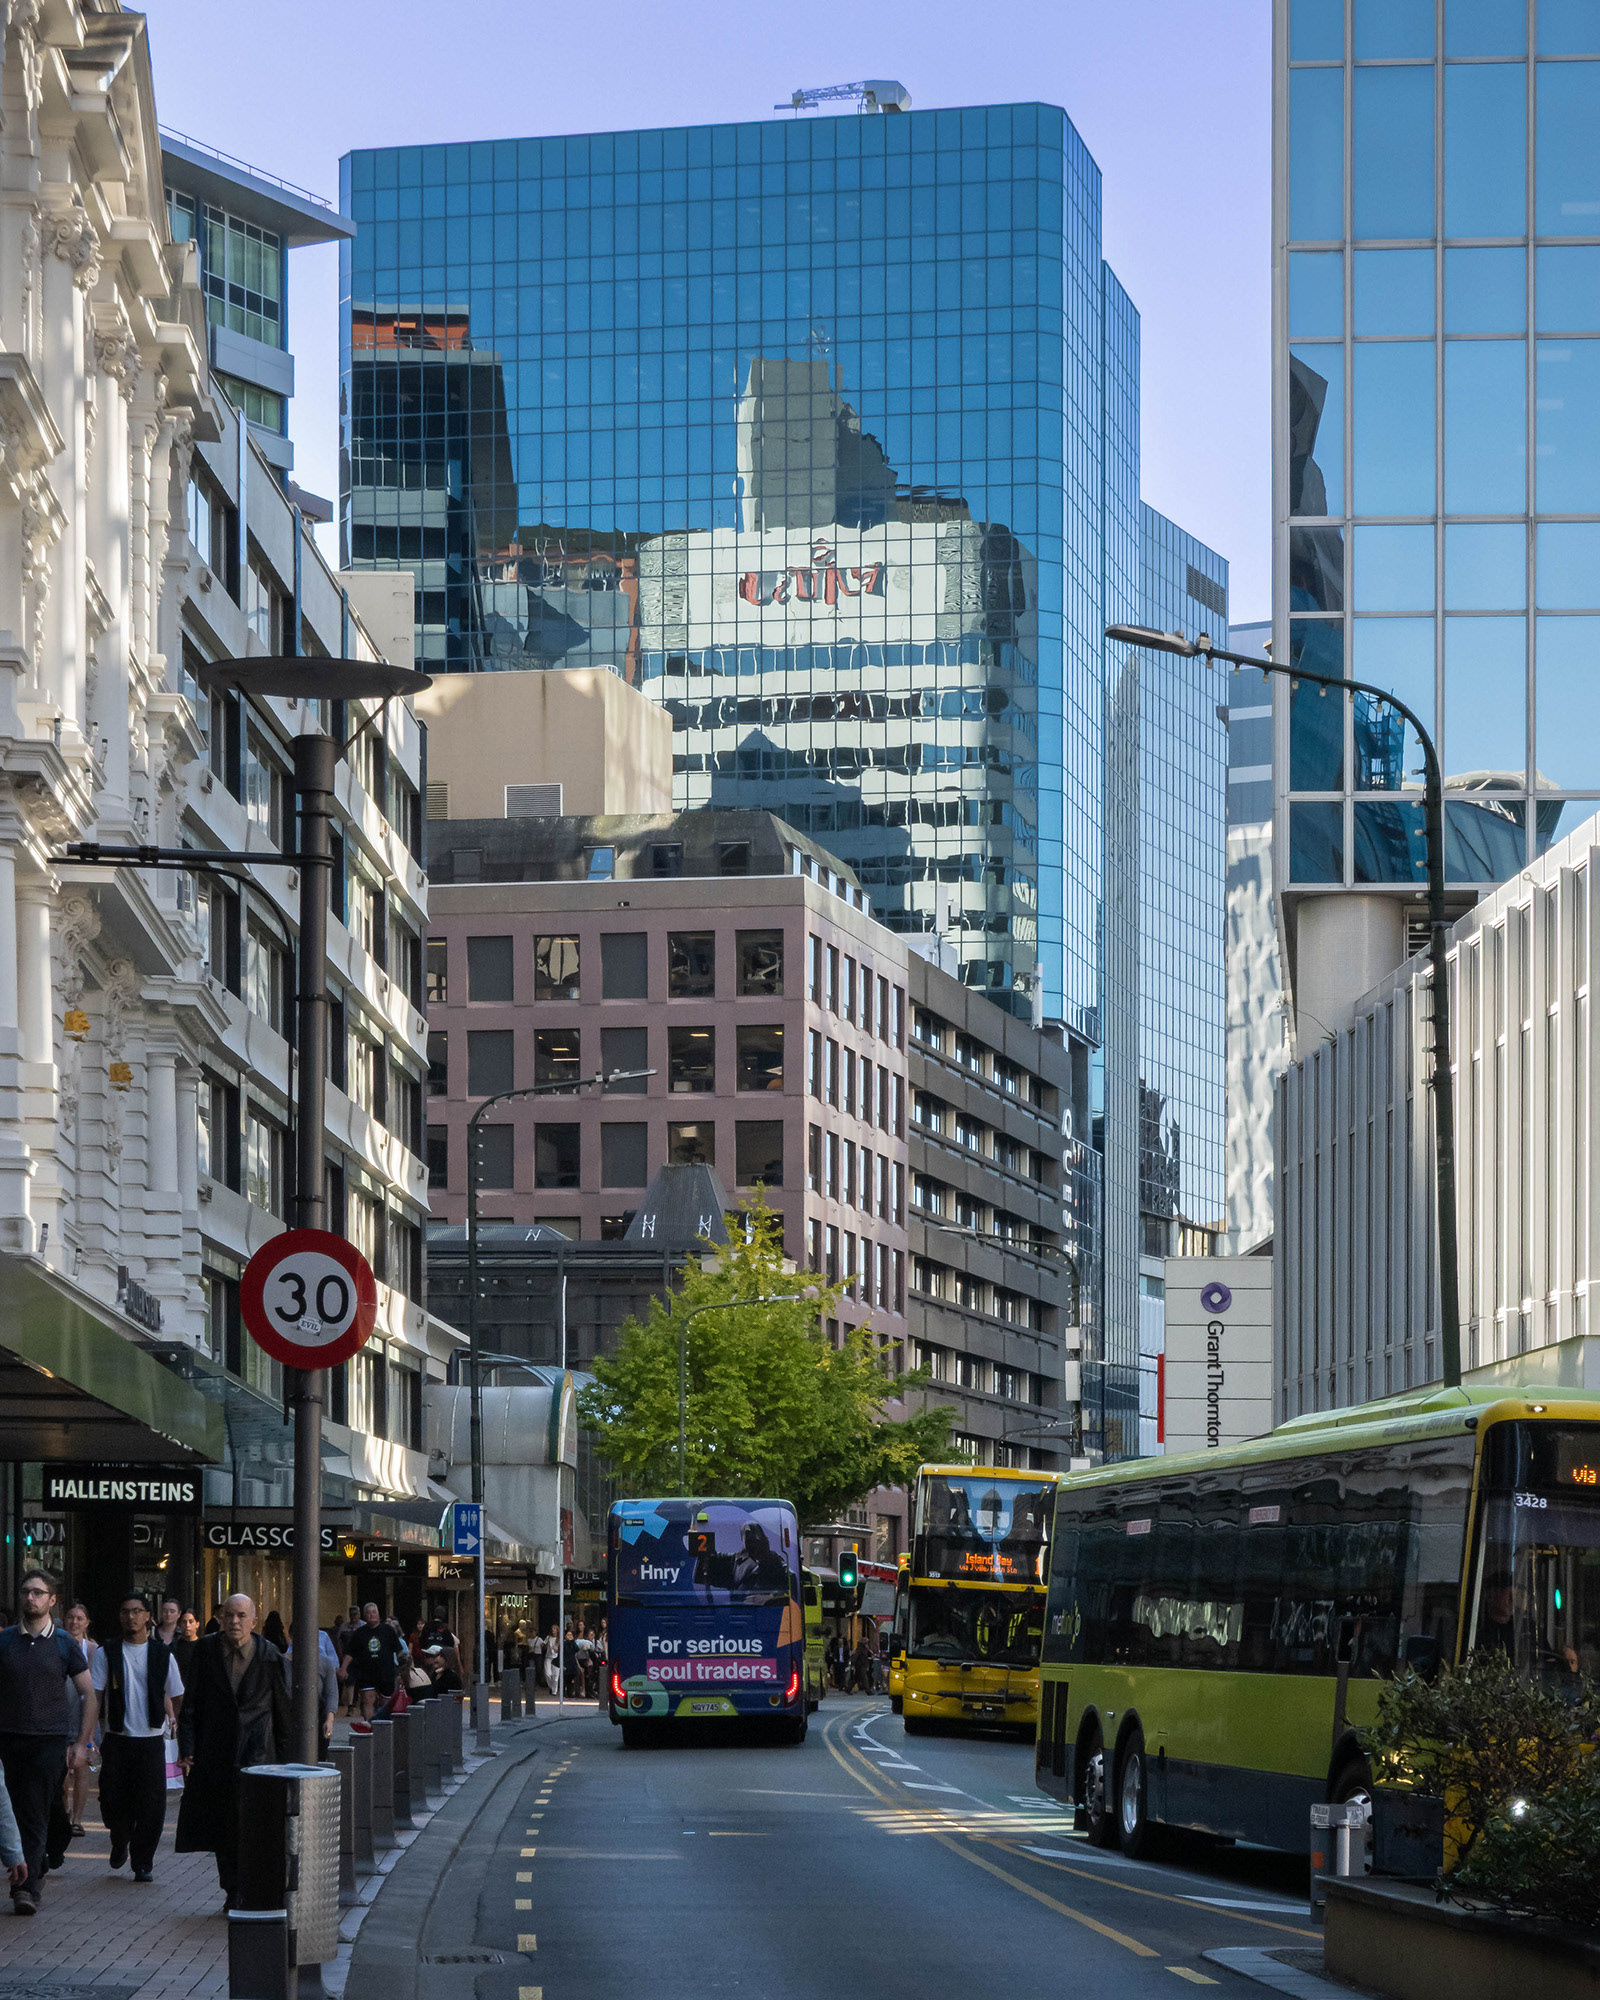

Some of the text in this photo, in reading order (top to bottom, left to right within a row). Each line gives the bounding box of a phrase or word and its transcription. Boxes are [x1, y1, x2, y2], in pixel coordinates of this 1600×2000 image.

[275, 1272, 349, 1324] 30
[300, 1321, 319, 1332] EVIL
[1207, 1320, 1225, 1448] Grant Thornton
[1572, 1464, 1597, 1484] via
[51, 1479, 194, 1502] HALLENSTEINS
[1515, 1496, 1547, 1508] 3428
[697, 1534, 707, 1551] 2
[966, 1553, 993, 1566] Island
[641, 1564, 680, 1584] Hnry
[648, 1634, 763, 1654] For serious
[648, 1661, 777, 1680] soul traders.
